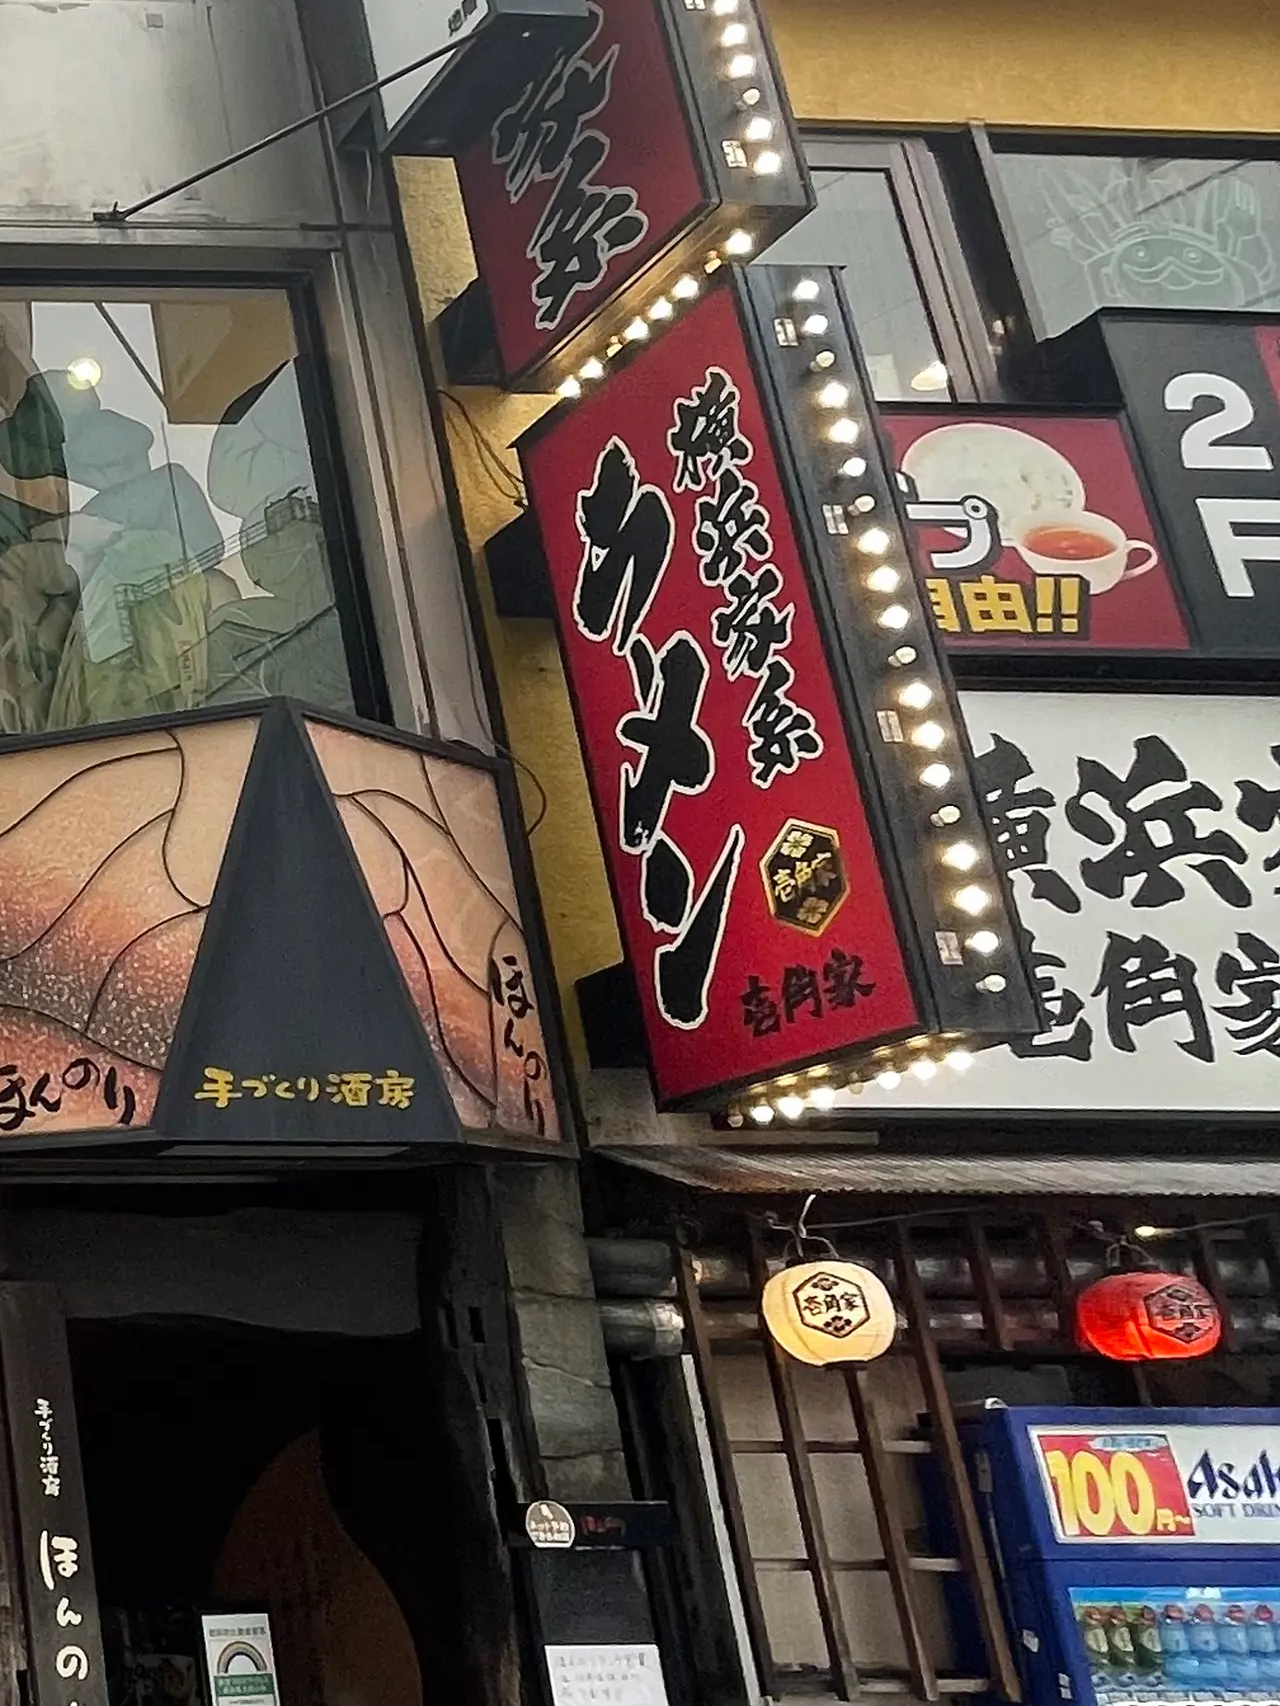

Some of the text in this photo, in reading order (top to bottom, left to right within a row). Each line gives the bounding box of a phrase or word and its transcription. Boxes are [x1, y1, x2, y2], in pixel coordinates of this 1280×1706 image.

[668, 366, 823, 790] 横浜家系
[192, 1066, 417, 1112] 手づくり酒房
